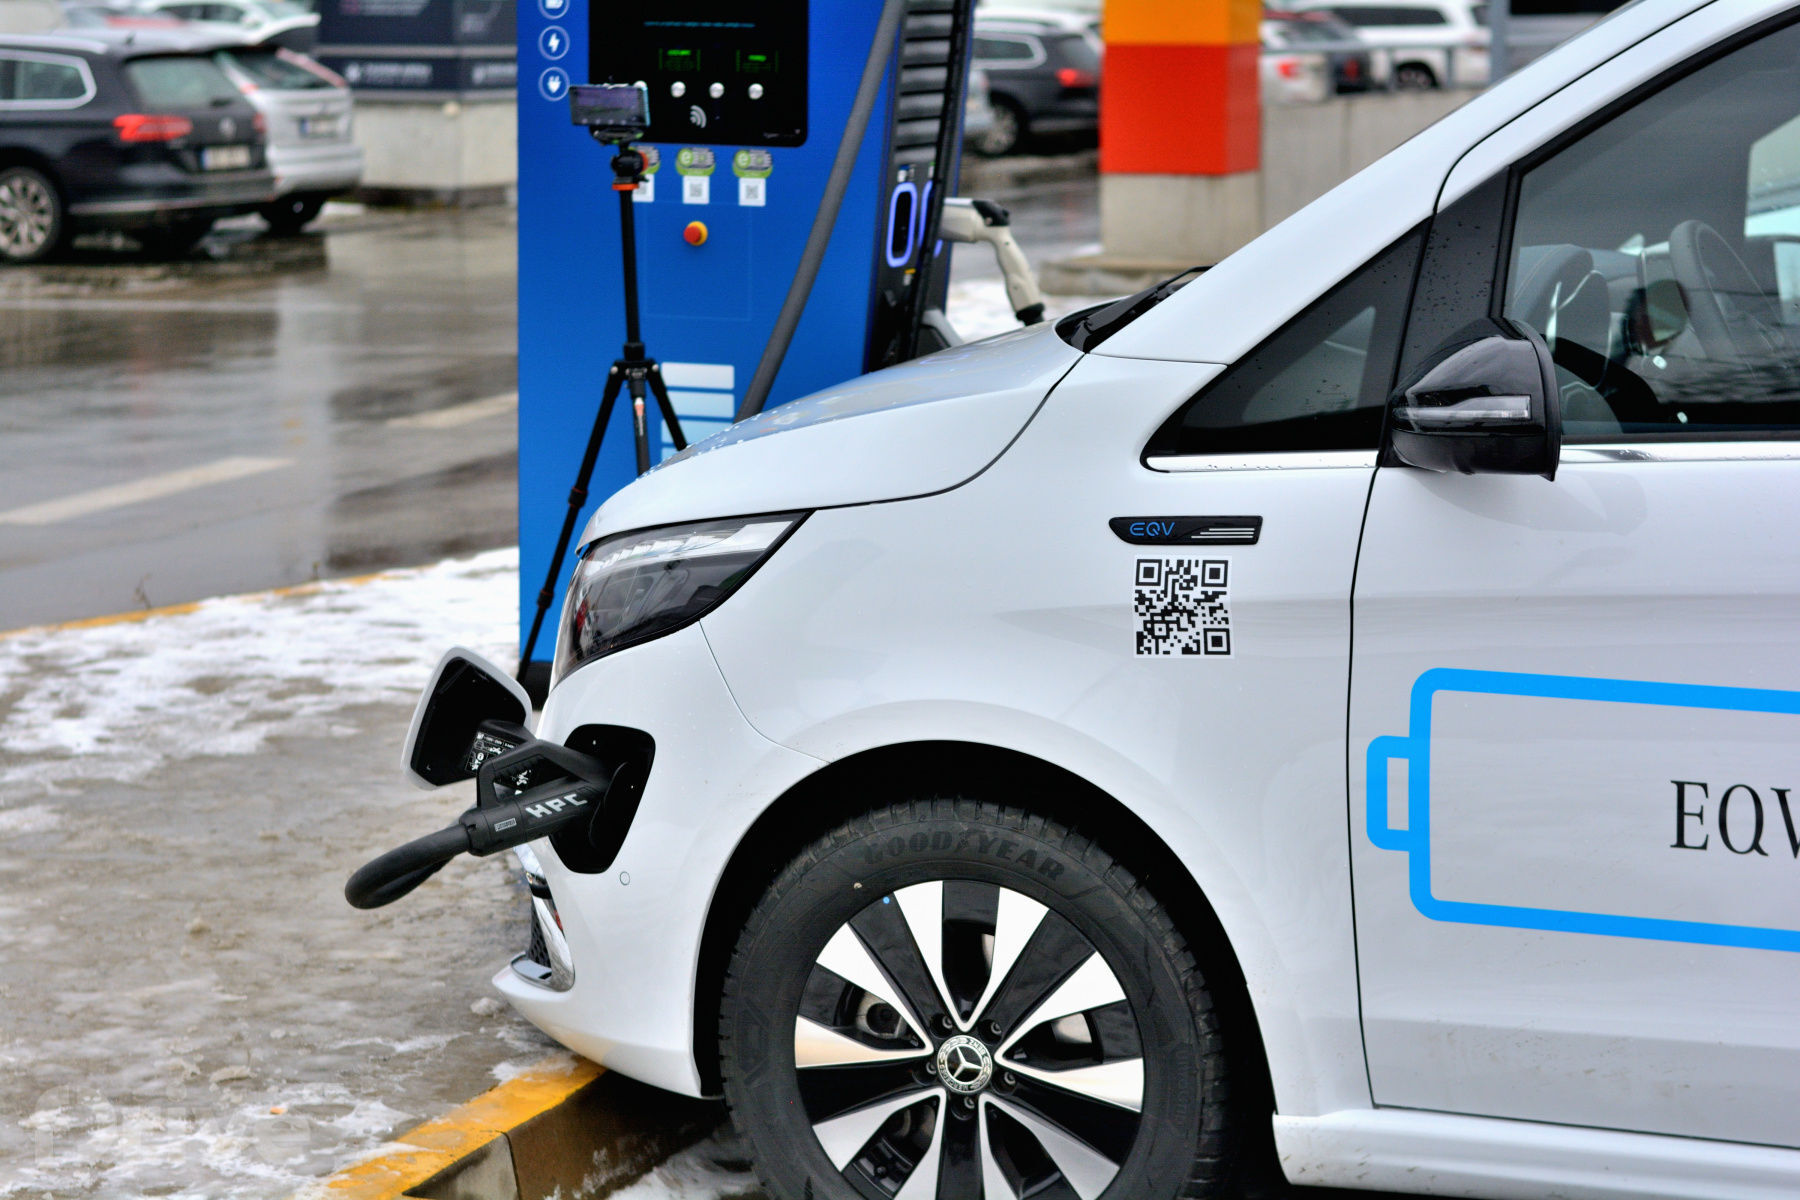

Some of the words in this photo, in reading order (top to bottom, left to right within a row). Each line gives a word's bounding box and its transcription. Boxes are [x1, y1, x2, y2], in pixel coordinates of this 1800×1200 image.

[1130, 521, 1176, 537] EQV
[525, 793, 588, 819] HPC
[1670, 779, 1800, 860] EQV
